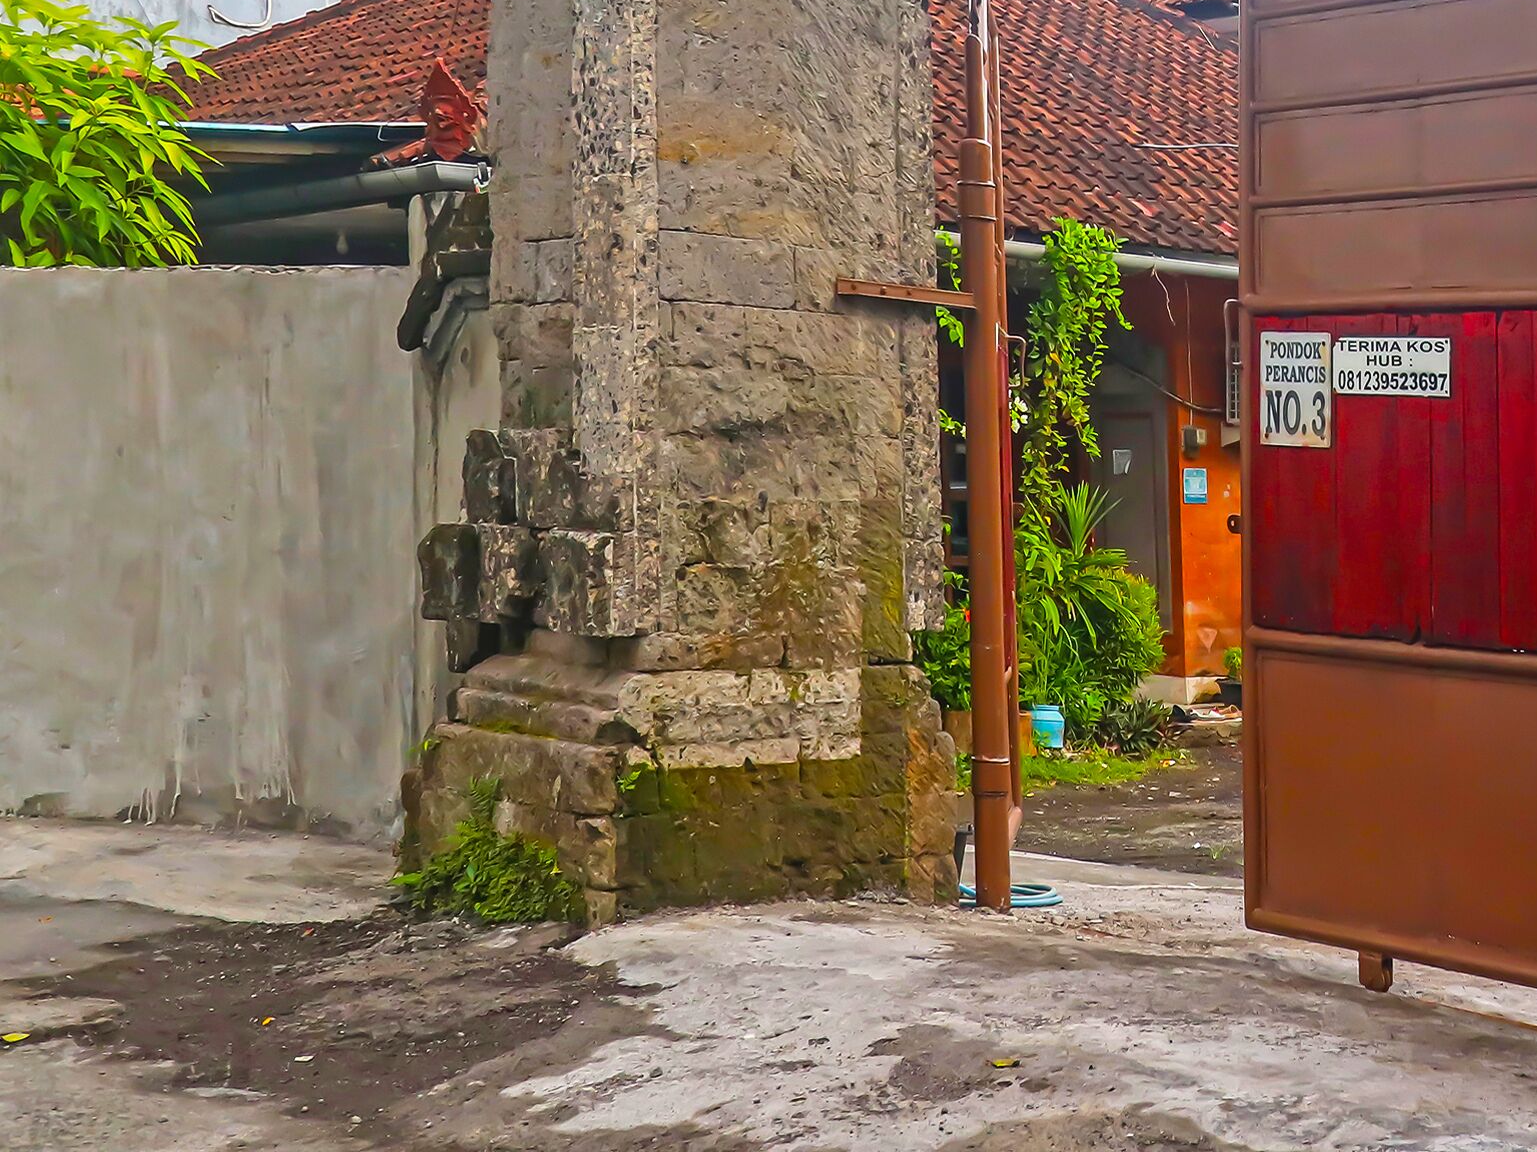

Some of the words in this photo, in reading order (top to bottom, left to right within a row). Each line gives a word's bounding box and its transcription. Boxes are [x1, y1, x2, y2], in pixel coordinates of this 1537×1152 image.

[1270, 341, 1322, 359] PONDOK
[1338, 340, 1402, 353] TERIMA
[1407, 341, 1445, 353] KOS
[1366, 355, 1403, 367] HUB
[1265, 365, 1326, 384] PERANCIS
[1338, 370, 1448, 392] 081239523697
